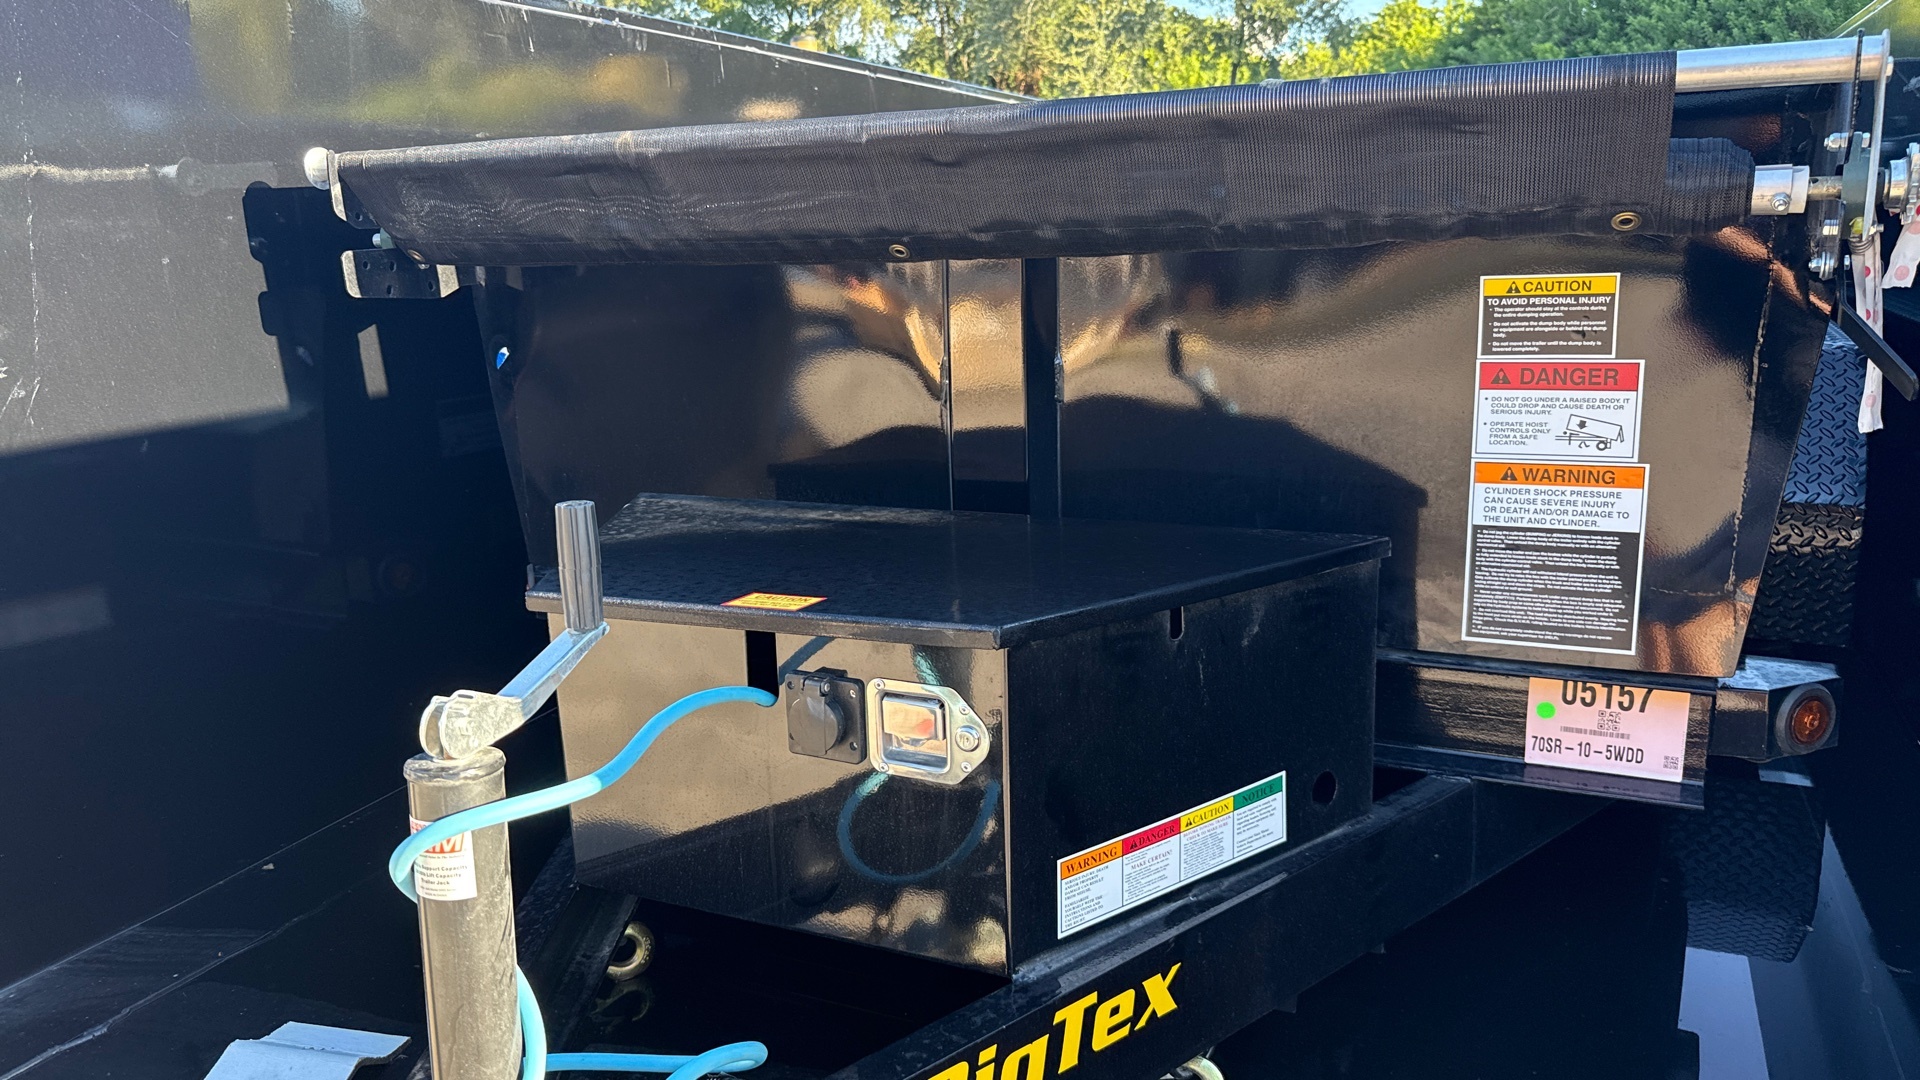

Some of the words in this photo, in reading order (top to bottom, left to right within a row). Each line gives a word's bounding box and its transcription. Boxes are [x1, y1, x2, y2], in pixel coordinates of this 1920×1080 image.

[1524, 280, 1592, 292] CAUTION
[1501, 298, 1528, 306] AVOID
[1530, 296, 1577, 305] PERSONAL
[1520, 368, 1619, 386] DANGER
[1522, 468, 1616, 485] WARNING
[1484, 487, 1530, 495] CYLINDER
[1533, 489, 1567, 497] SHOCK
[1570, 490, 1622, 499] PRESSURE
[1506, 497, 1538, 505] CAUSE
[1540, 499, 1578, 507] SEVERE
[1572, 510, 1614, 518] DAMAGE
[1549, 518, 1600, 527] CYLINDER.
[1242, 784, 1274, 804] NOTICE
[1192, 802, 1230, 824] CAUTION
[1138, 825, 1175, 846] DANGER
[1066, 847, 1117, 874] WARNING
[1131, 860, 1146, 870] MAKE
[928, 962, 1182, 1080] igTex
